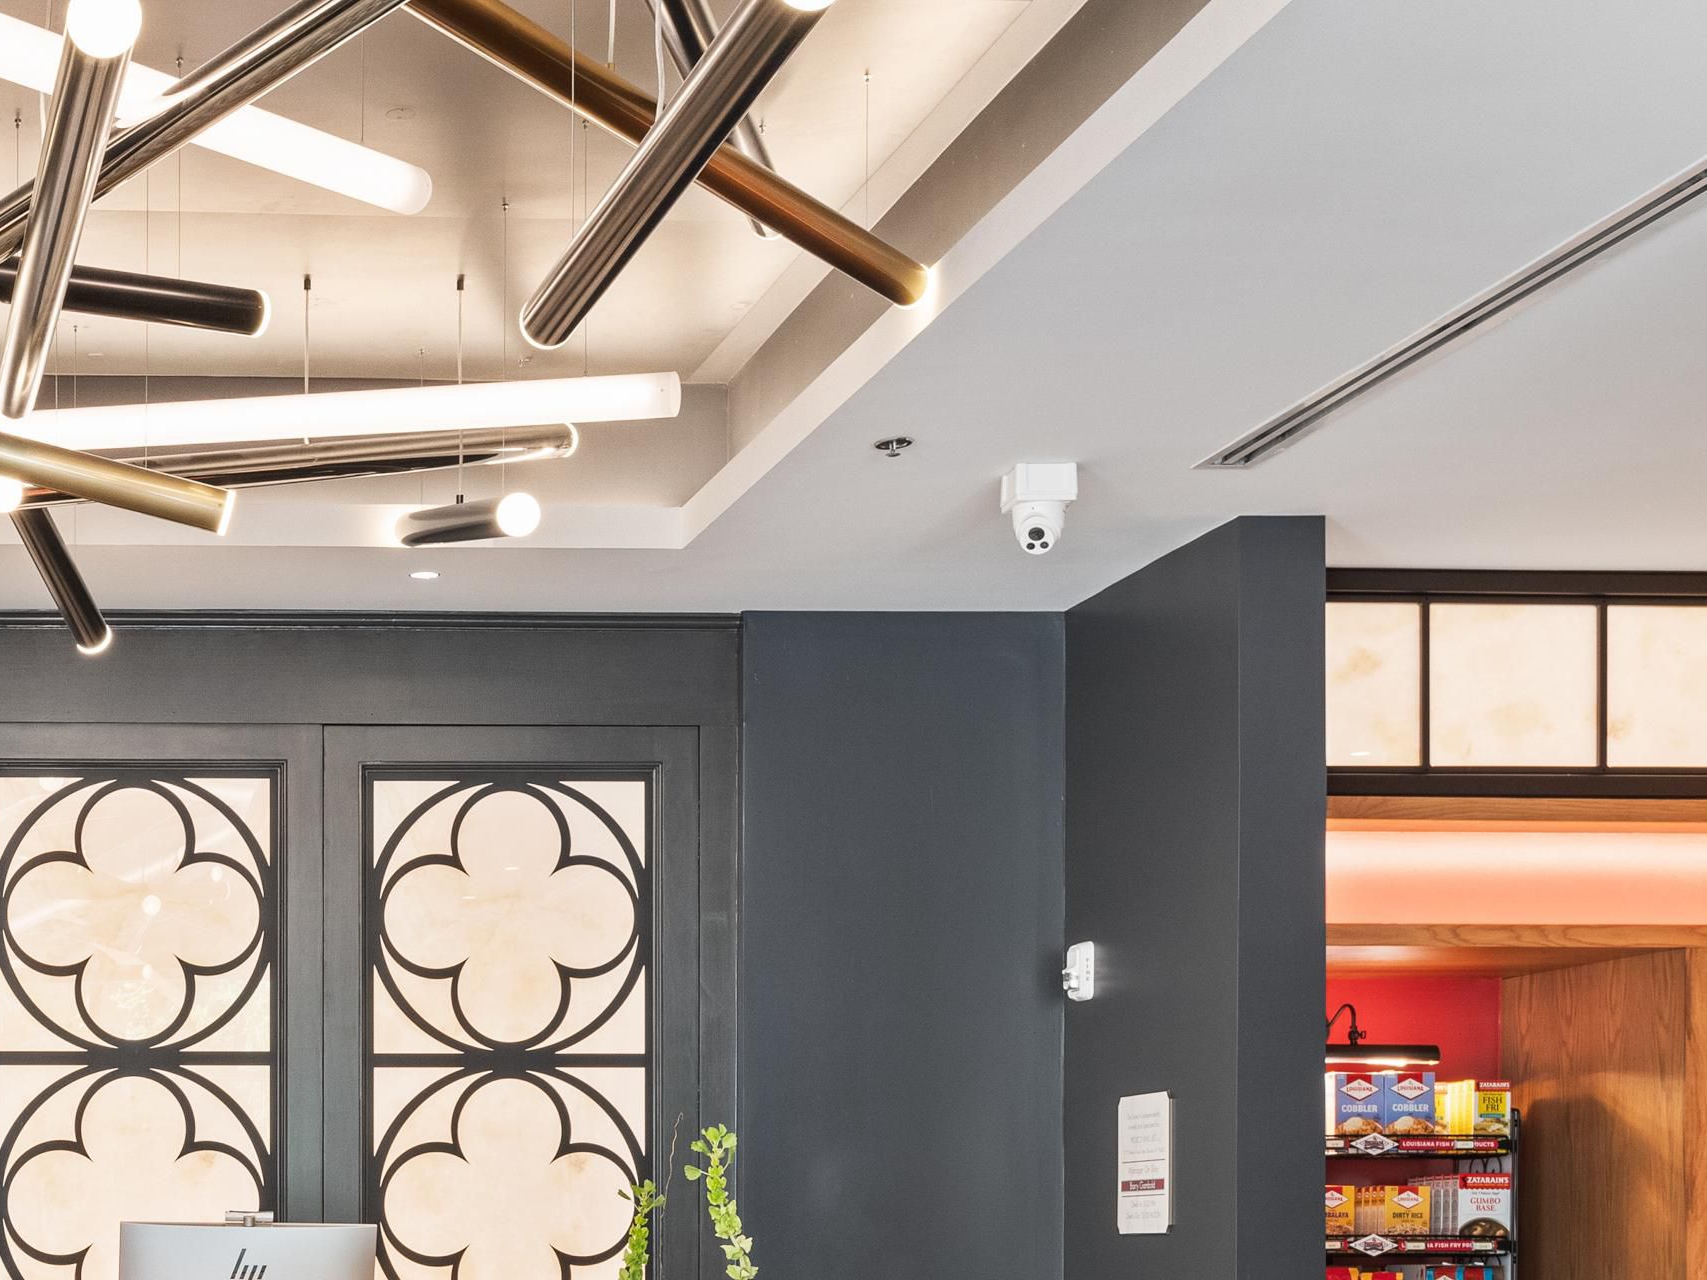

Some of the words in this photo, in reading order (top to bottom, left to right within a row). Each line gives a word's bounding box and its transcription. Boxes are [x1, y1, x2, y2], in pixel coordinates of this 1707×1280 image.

[1482, 1096, 1503, 1104] FISH
[1341, 1104, 1378, 1113] COBBLER
[1392, 1103, 1429, 1112] COBBLER
[1470, 1197, 1501, 1205] GUMBO
